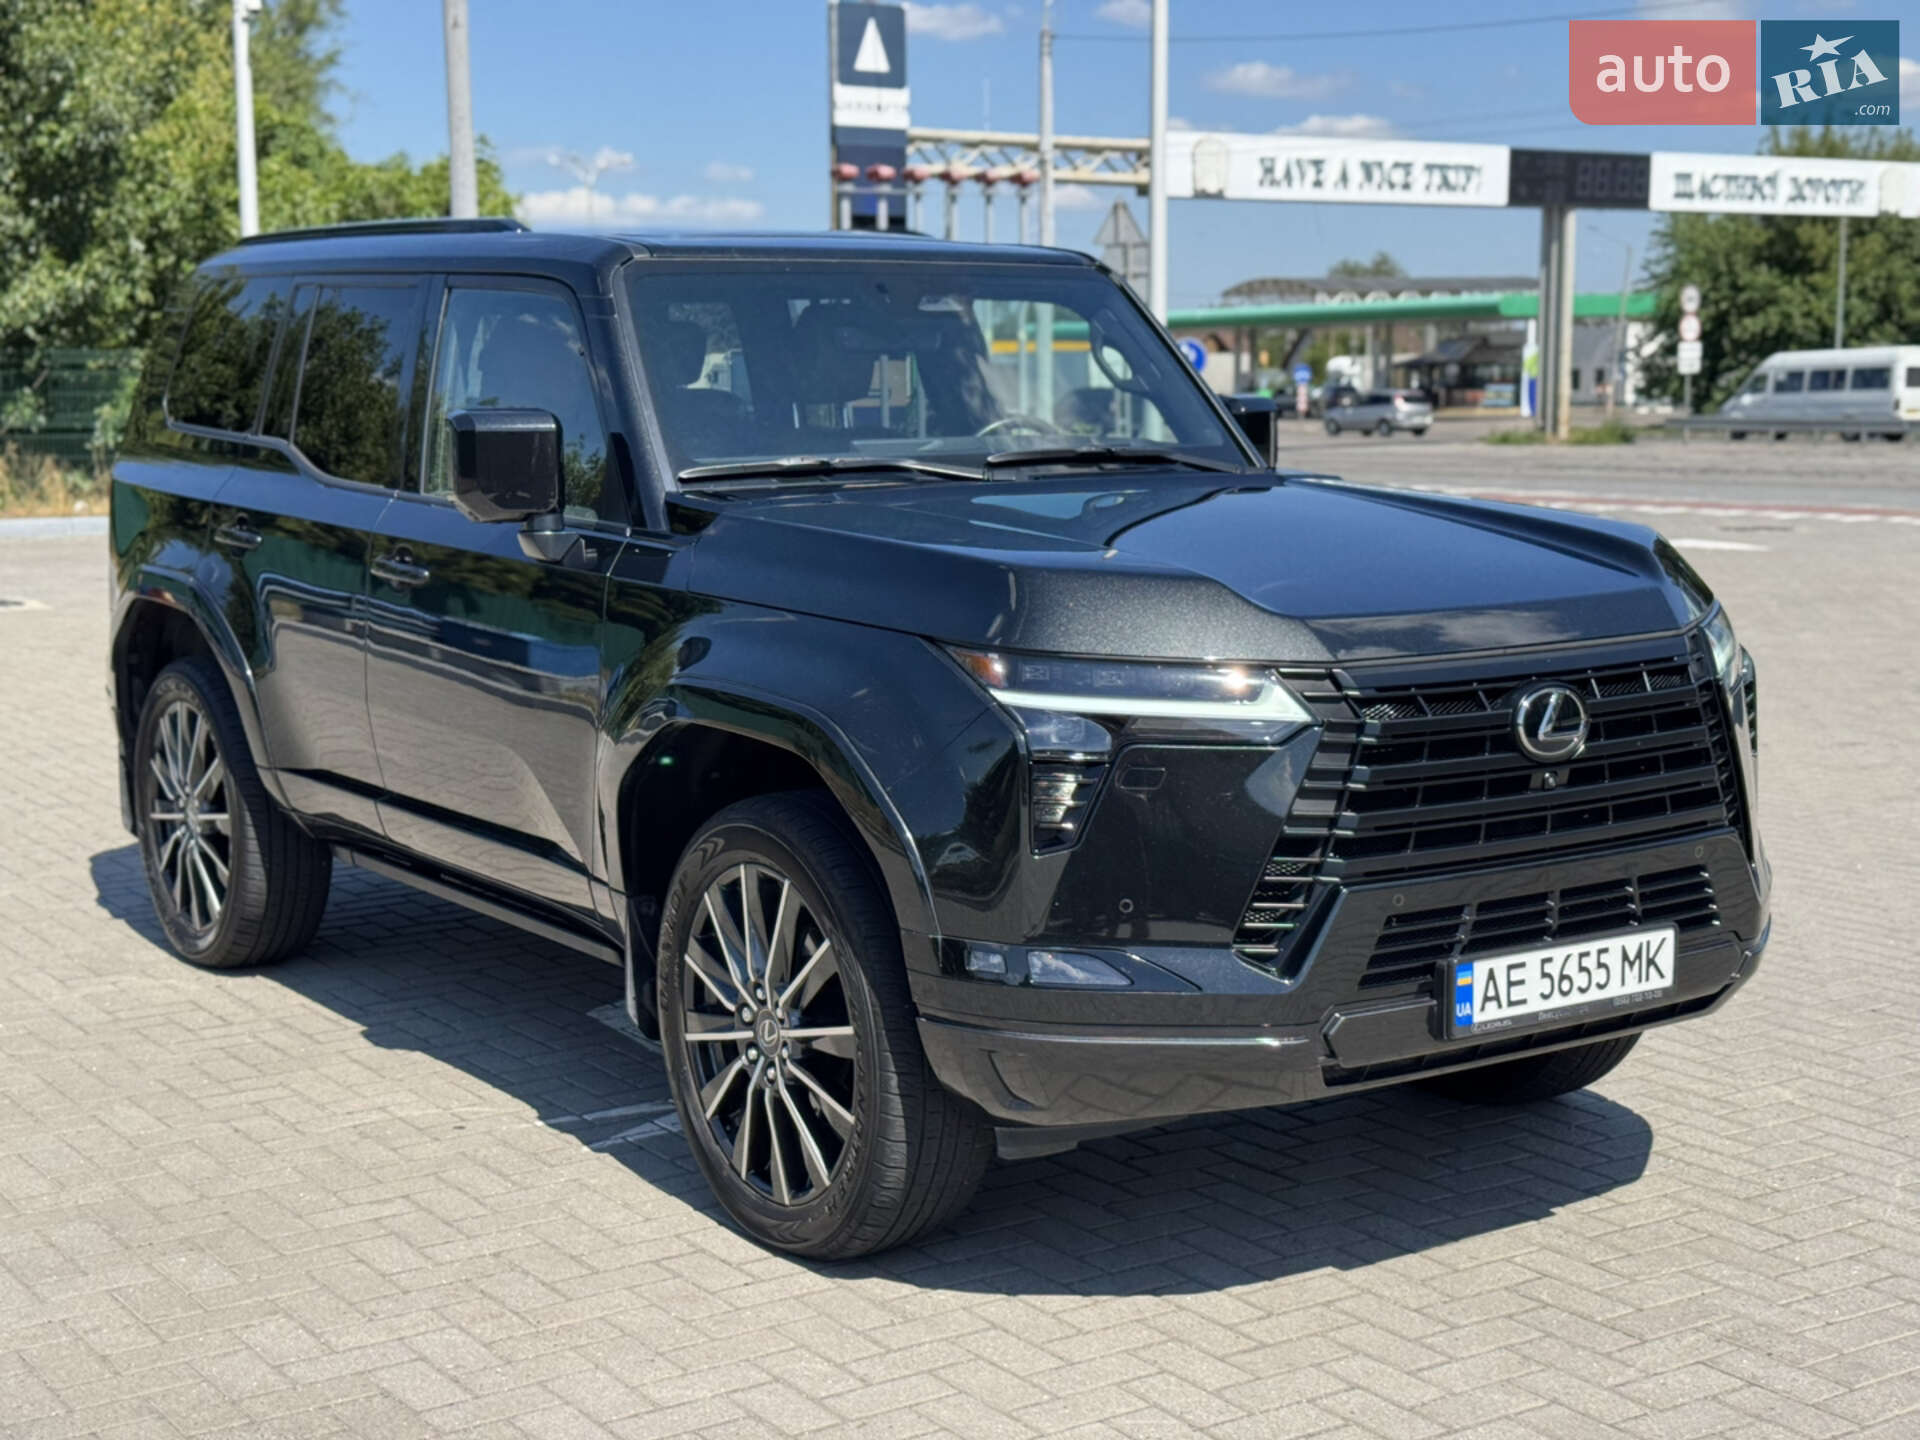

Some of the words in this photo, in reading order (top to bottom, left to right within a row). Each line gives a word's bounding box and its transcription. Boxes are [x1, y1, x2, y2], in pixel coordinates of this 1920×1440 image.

[1258, 156, 1325, 188] HAVE
[1333, 158, 1350, 191] A
[1359, 160, 1413, 192] NICE
[1479, 961, 1528, 1013] AE
[1539, 947, 1611, 1000] 5655
[1620, 937, 1667, 987] MK
[1456, 1002, 1473, 1018] UA
